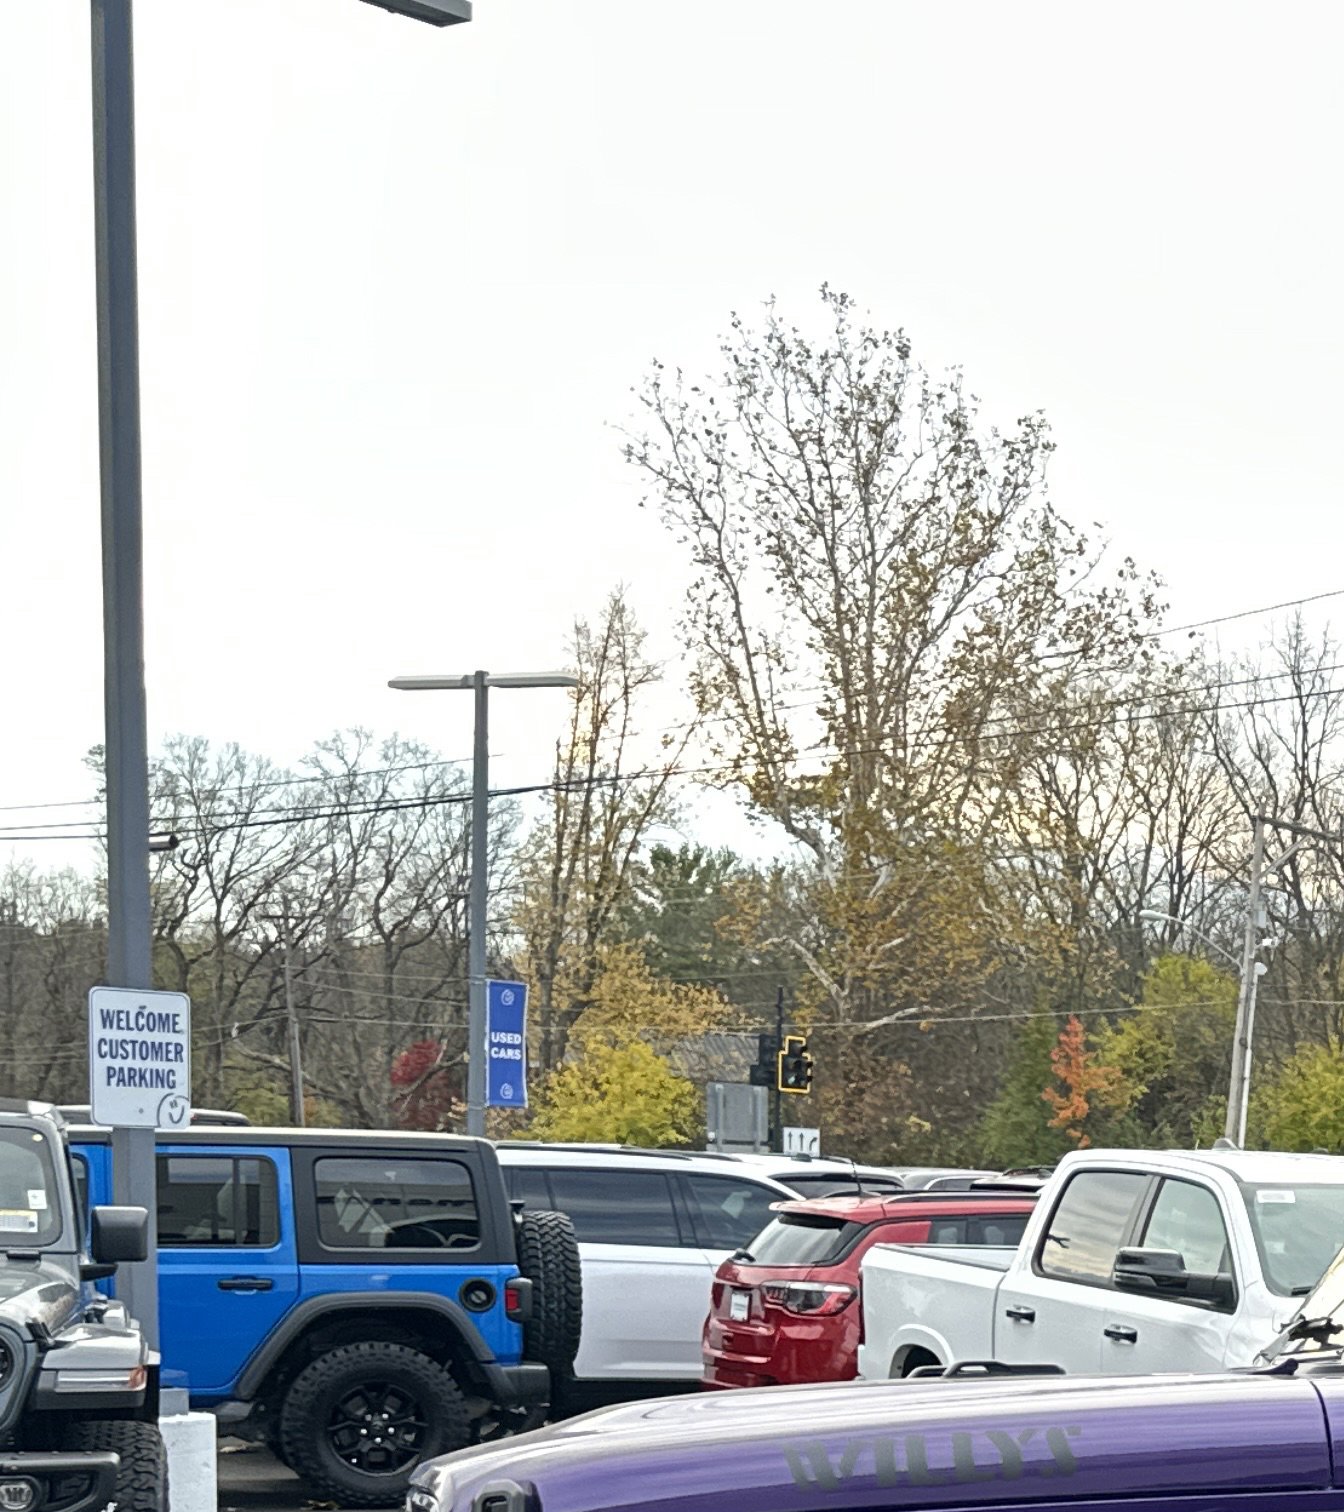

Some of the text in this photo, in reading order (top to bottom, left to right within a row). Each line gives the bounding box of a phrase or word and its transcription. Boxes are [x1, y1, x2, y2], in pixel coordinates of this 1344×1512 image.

[100, 1008, 183, 1033] WELCOME
[97, 1038, 184, 1063] CUSTOMER
[490, 1032, 522, 1045] USED
[490, 1047, 522, 1061] CARS
[106, 1066, 176, 1089] PARKING
[784, 1426, 1083, 1492] WILLYS
